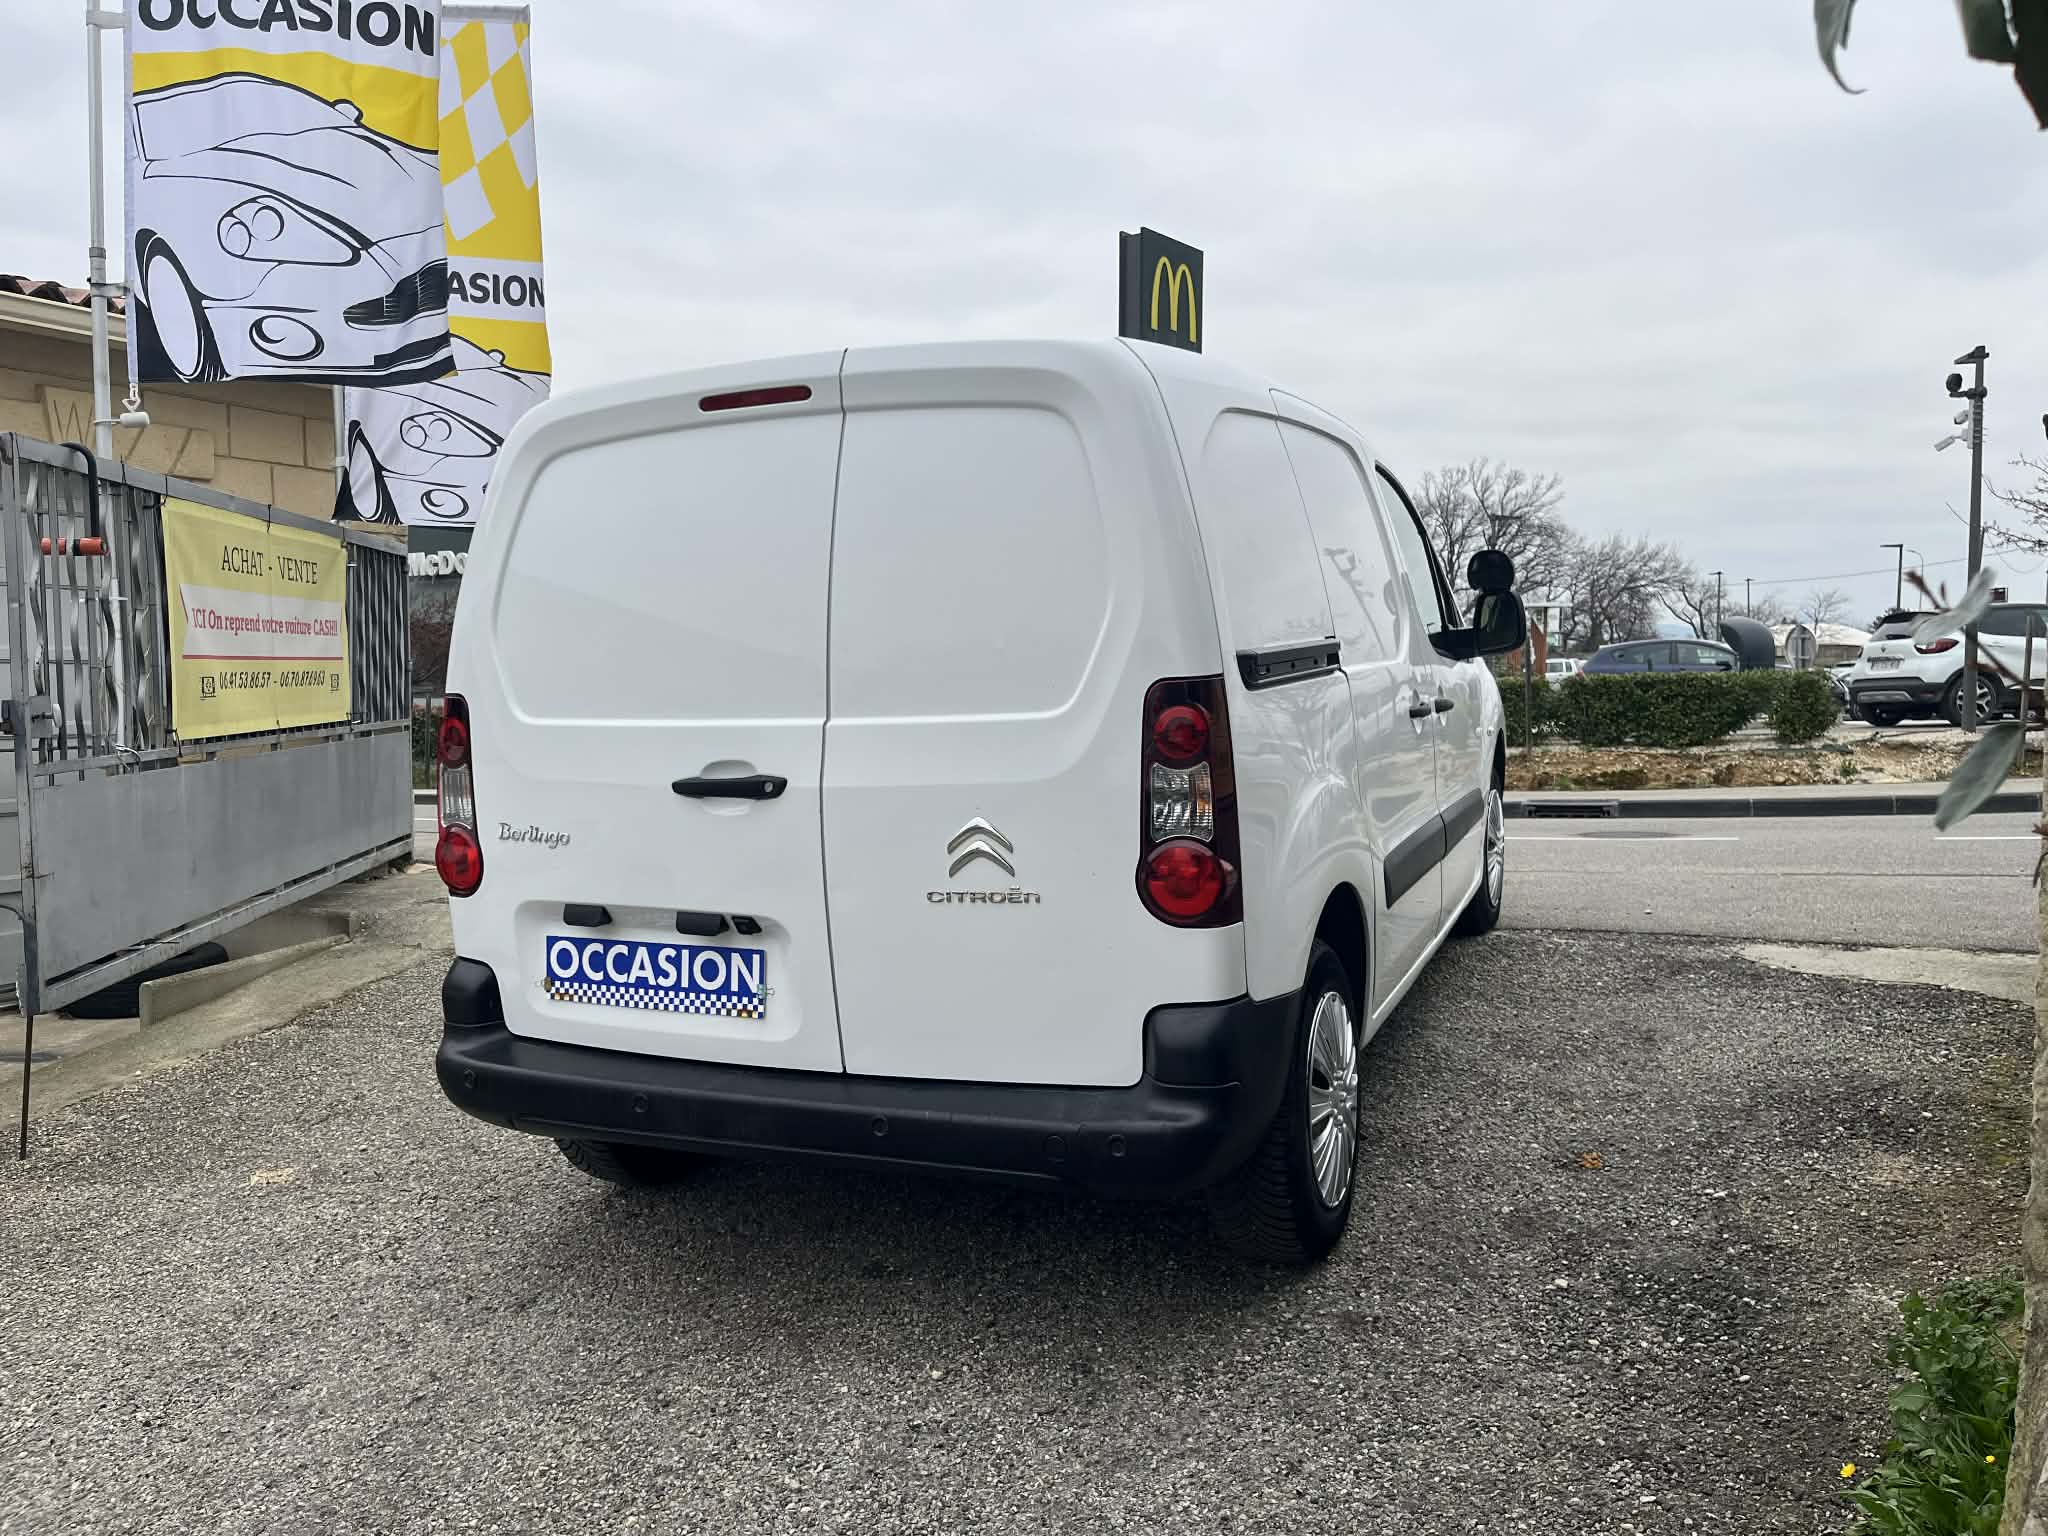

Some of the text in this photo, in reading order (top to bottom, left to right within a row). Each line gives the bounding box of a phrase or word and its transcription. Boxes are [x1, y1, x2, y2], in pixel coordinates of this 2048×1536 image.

[138, 0, 435, 56] OCCASION
[221, 545, 264, 577] ACHAT
[277, 556, 318, 584] VENTE
[208, 609, 223, 630] On
[225, 613, 261, 637] reprend
[261, 615, 285, 634] votre
[285, 616, 312, 636] voiture
[498, 822, 570, 849] Berlingo
[550, 940, 760, 993] OCCASION
